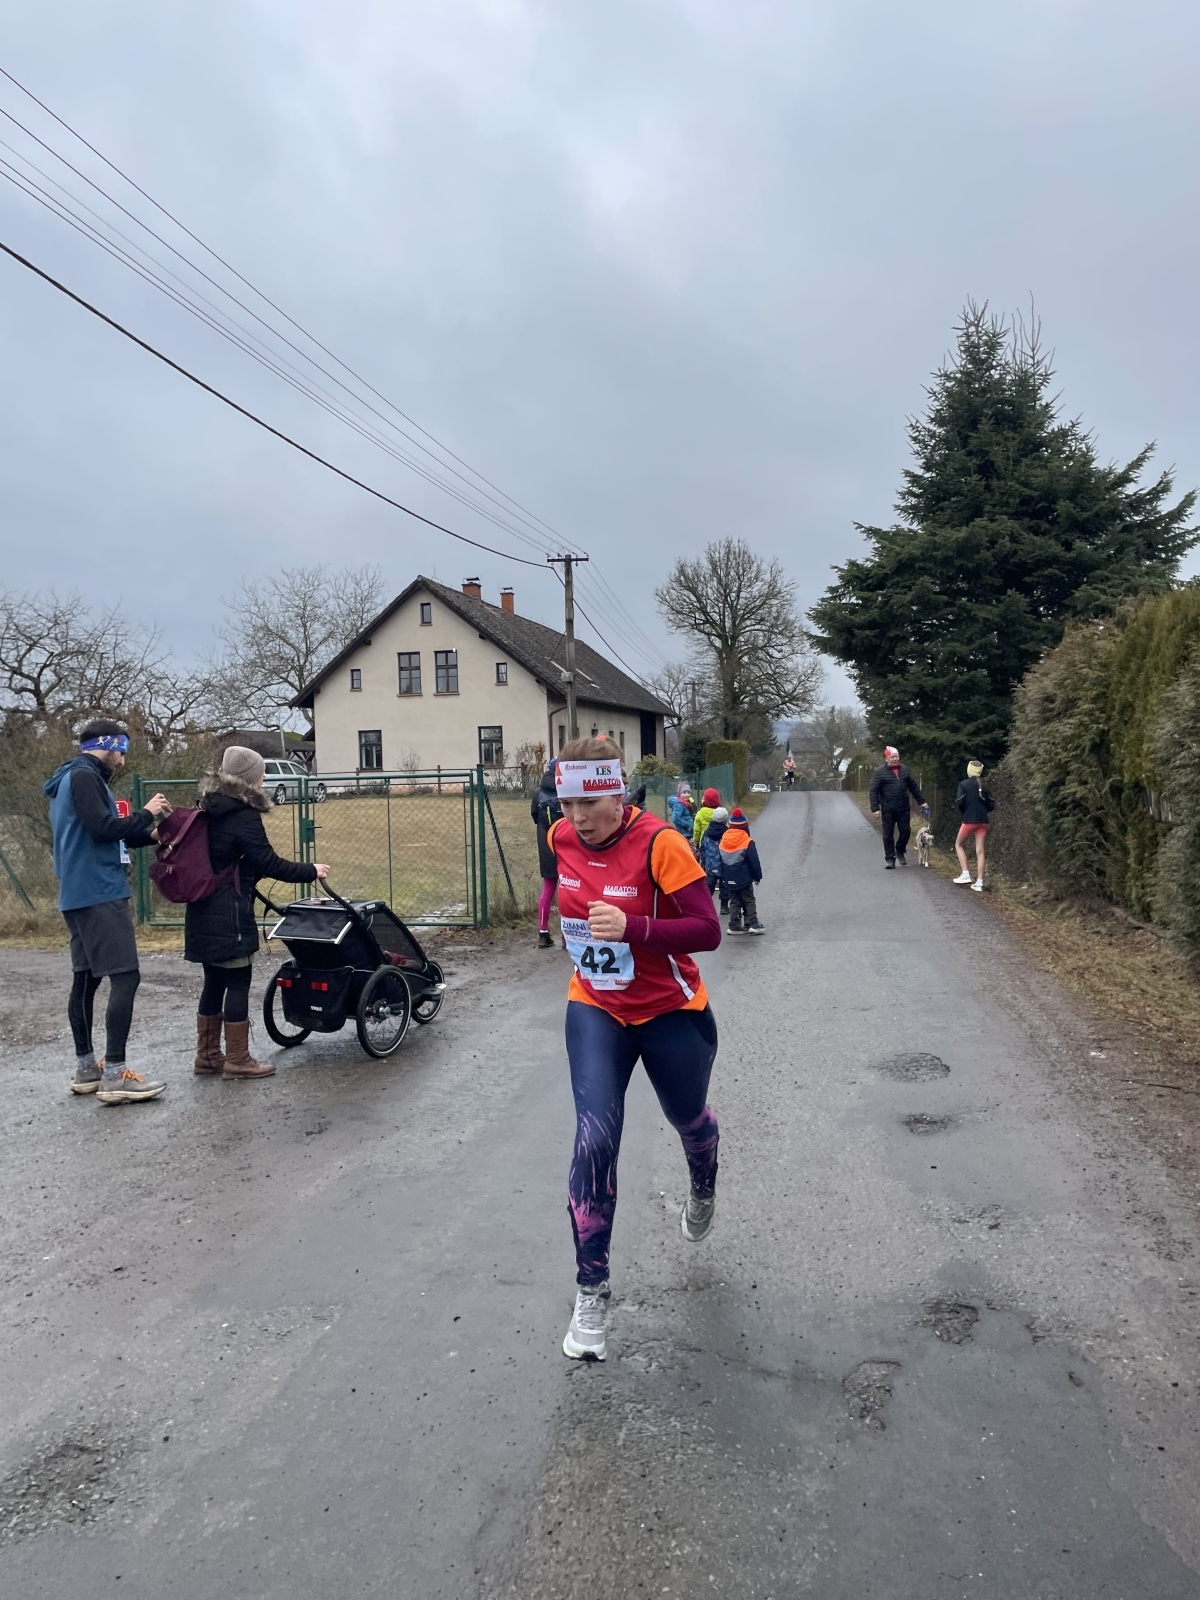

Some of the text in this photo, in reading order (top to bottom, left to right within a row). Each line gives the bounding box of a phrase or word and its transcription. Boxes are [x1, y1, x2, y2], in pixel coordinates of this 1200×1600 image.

[596, 767, 612, 776] LES
[583, 778, 621, 787] MARATON
[604, 885, 638, 893] MARATON
[580, 946, 620, 974] 42
